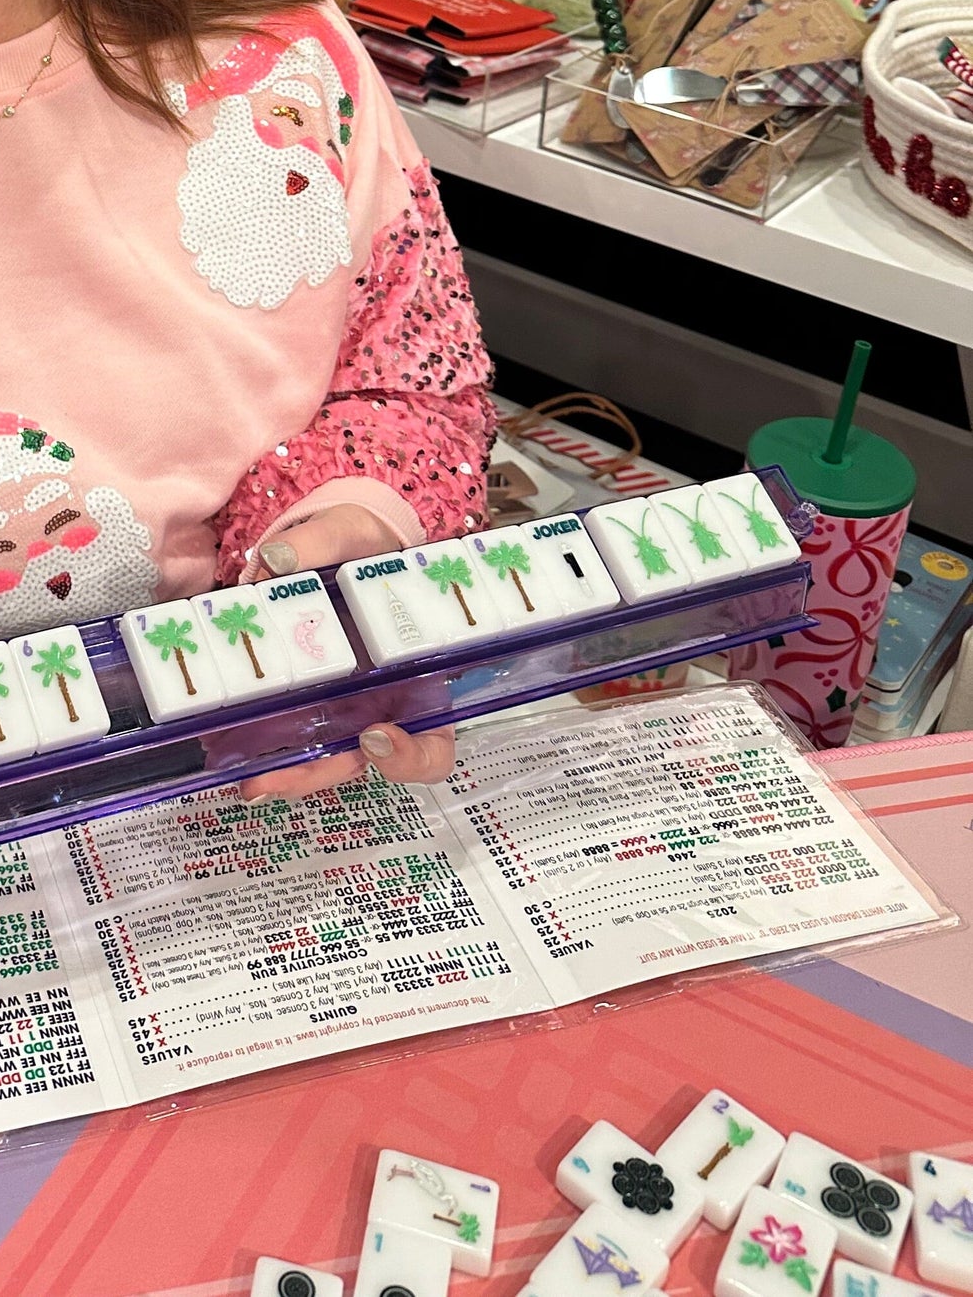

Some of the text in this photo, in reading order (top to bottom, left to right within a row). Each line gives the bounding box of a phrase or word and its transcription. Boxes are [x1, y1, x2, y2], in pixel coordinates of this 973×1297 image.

[532, 518, 582, 541] JOKER
[473, 537, 486, 553] 8
[415, 551, 428, 567] 8
[355, 556, 408, 582] JOKER
[268, 577, 322, 603] JOKER
[202, 599, 214, 616] 7
[135, 615, 147, 632] 7
[22, 640, 34, 657] 6
[562, 748, 666, 778] ANY LIKE NUMBERS
[791, 845, 816, 856] 000
[814, 840, 840, 852] 222
[841, 838, 855, 848] FF
[667, 850, 697, 863] 2468
[724, 855, 744, 866] (Any
[743, 853, 768, 865] 555
[767, 848, 792, 860] 222
[246, 861, 283, 879] 13579
[692, 860, 720, 873] Suits)
[523, 903, 541, 916] 30
[542, 900, 553, 909] C
[706, 905, 738, 919] 2025
[547, 939, 595, 959] VALUES
[250, 945, 368, 981] CONSECUTIVE RUN
[497, 963, 512, 975] FF
[435, 970, 469, 985] 2222
[471, 965, 495, 979] 111
[370, 980, 391, 995] (Any
[393, 976, 435, 993] 33333
[24, 991, 42, 1004] EE
[46, 986, 69, 1000] NN
[469, 995, 491, 1005] This
[318, 996, 335, 1007] Any
[425, 998, 470, 1014] document
[309, 1005, 358, 1024] QUINTS
[361, 1017, 374, 1026] by
[373, 1007, 417, 1026] protected
[317, 1020, 360, 1037] copyright
[23, 1039, 54, 1055] DDD
[56, 1031, 84, 1049] FFFF
[136, 1041, 155, 1054] 40
[156, 1036, 168, 1048] X
[245, 1040, 274, 1055] illegal
[283, 1036, 293, 1045] It
[140, 1044, 193, 1066] VALUES
[234, 1047, 246, 1056] to
[186, 1050, 234, 1069] reproduce
[24, 1080, 48, 1095] EEE
[51, 1071, 96, 1090] NNNN
[713, 1098, 730, 1115] 2
